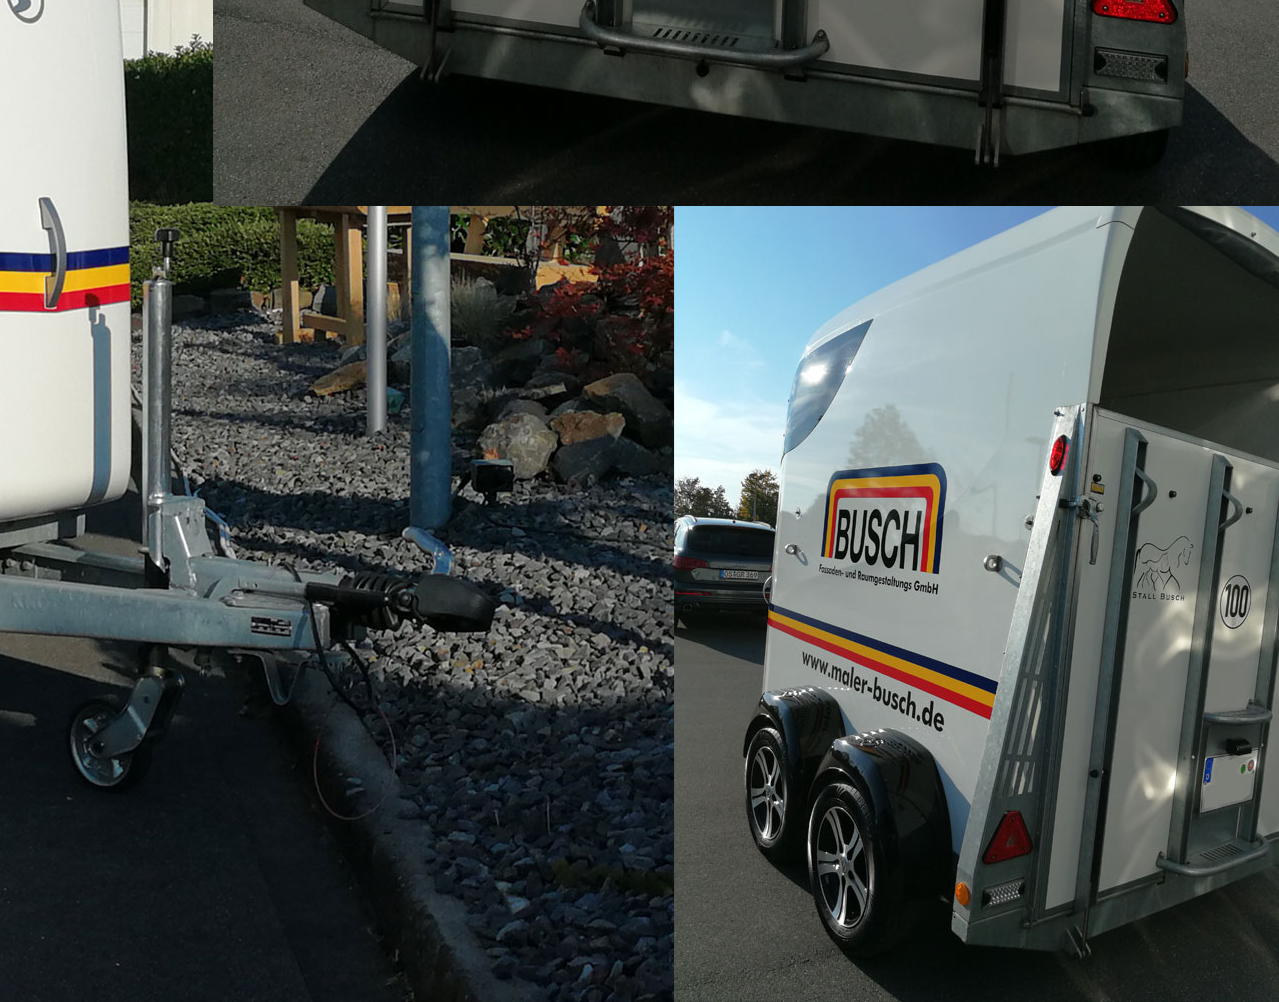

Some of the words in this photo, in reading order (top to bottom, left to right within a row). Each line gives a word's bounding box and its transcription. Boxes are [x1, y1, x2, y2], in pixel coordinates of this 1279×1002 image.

[834, 509, 923, 571] BUSCH
[819, 564, 844, 579] Fassaden-
[845, 569, 856, 580] und
[857, 570, 912, 592] Raumgestaltungs
[913, 580, 939, 595] GmbH
[1224, 584, 1249, 619] 100
[802, 651, 945, 732] www.maler-busch.de
